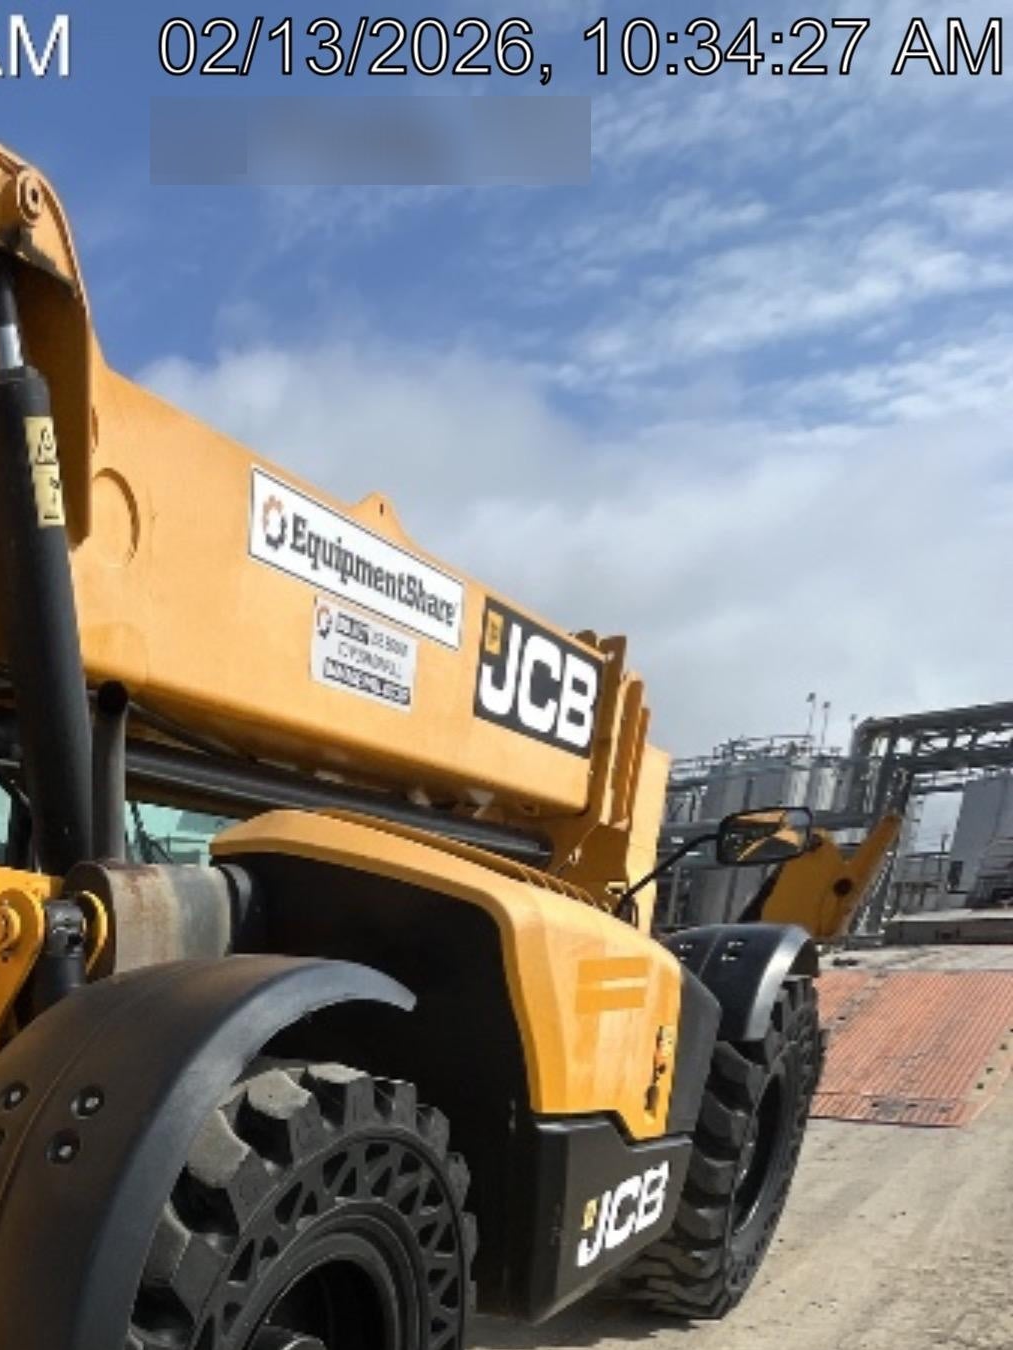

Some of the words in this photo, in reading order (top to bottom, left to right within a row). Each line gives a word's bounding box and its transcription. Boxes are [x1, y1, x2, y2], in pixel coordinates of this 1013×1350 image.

[290, 511, 456, 627] EquipmentShare
[479, 622, 597, 748] JCB
[577, 1160, 669, 1267] JCB
